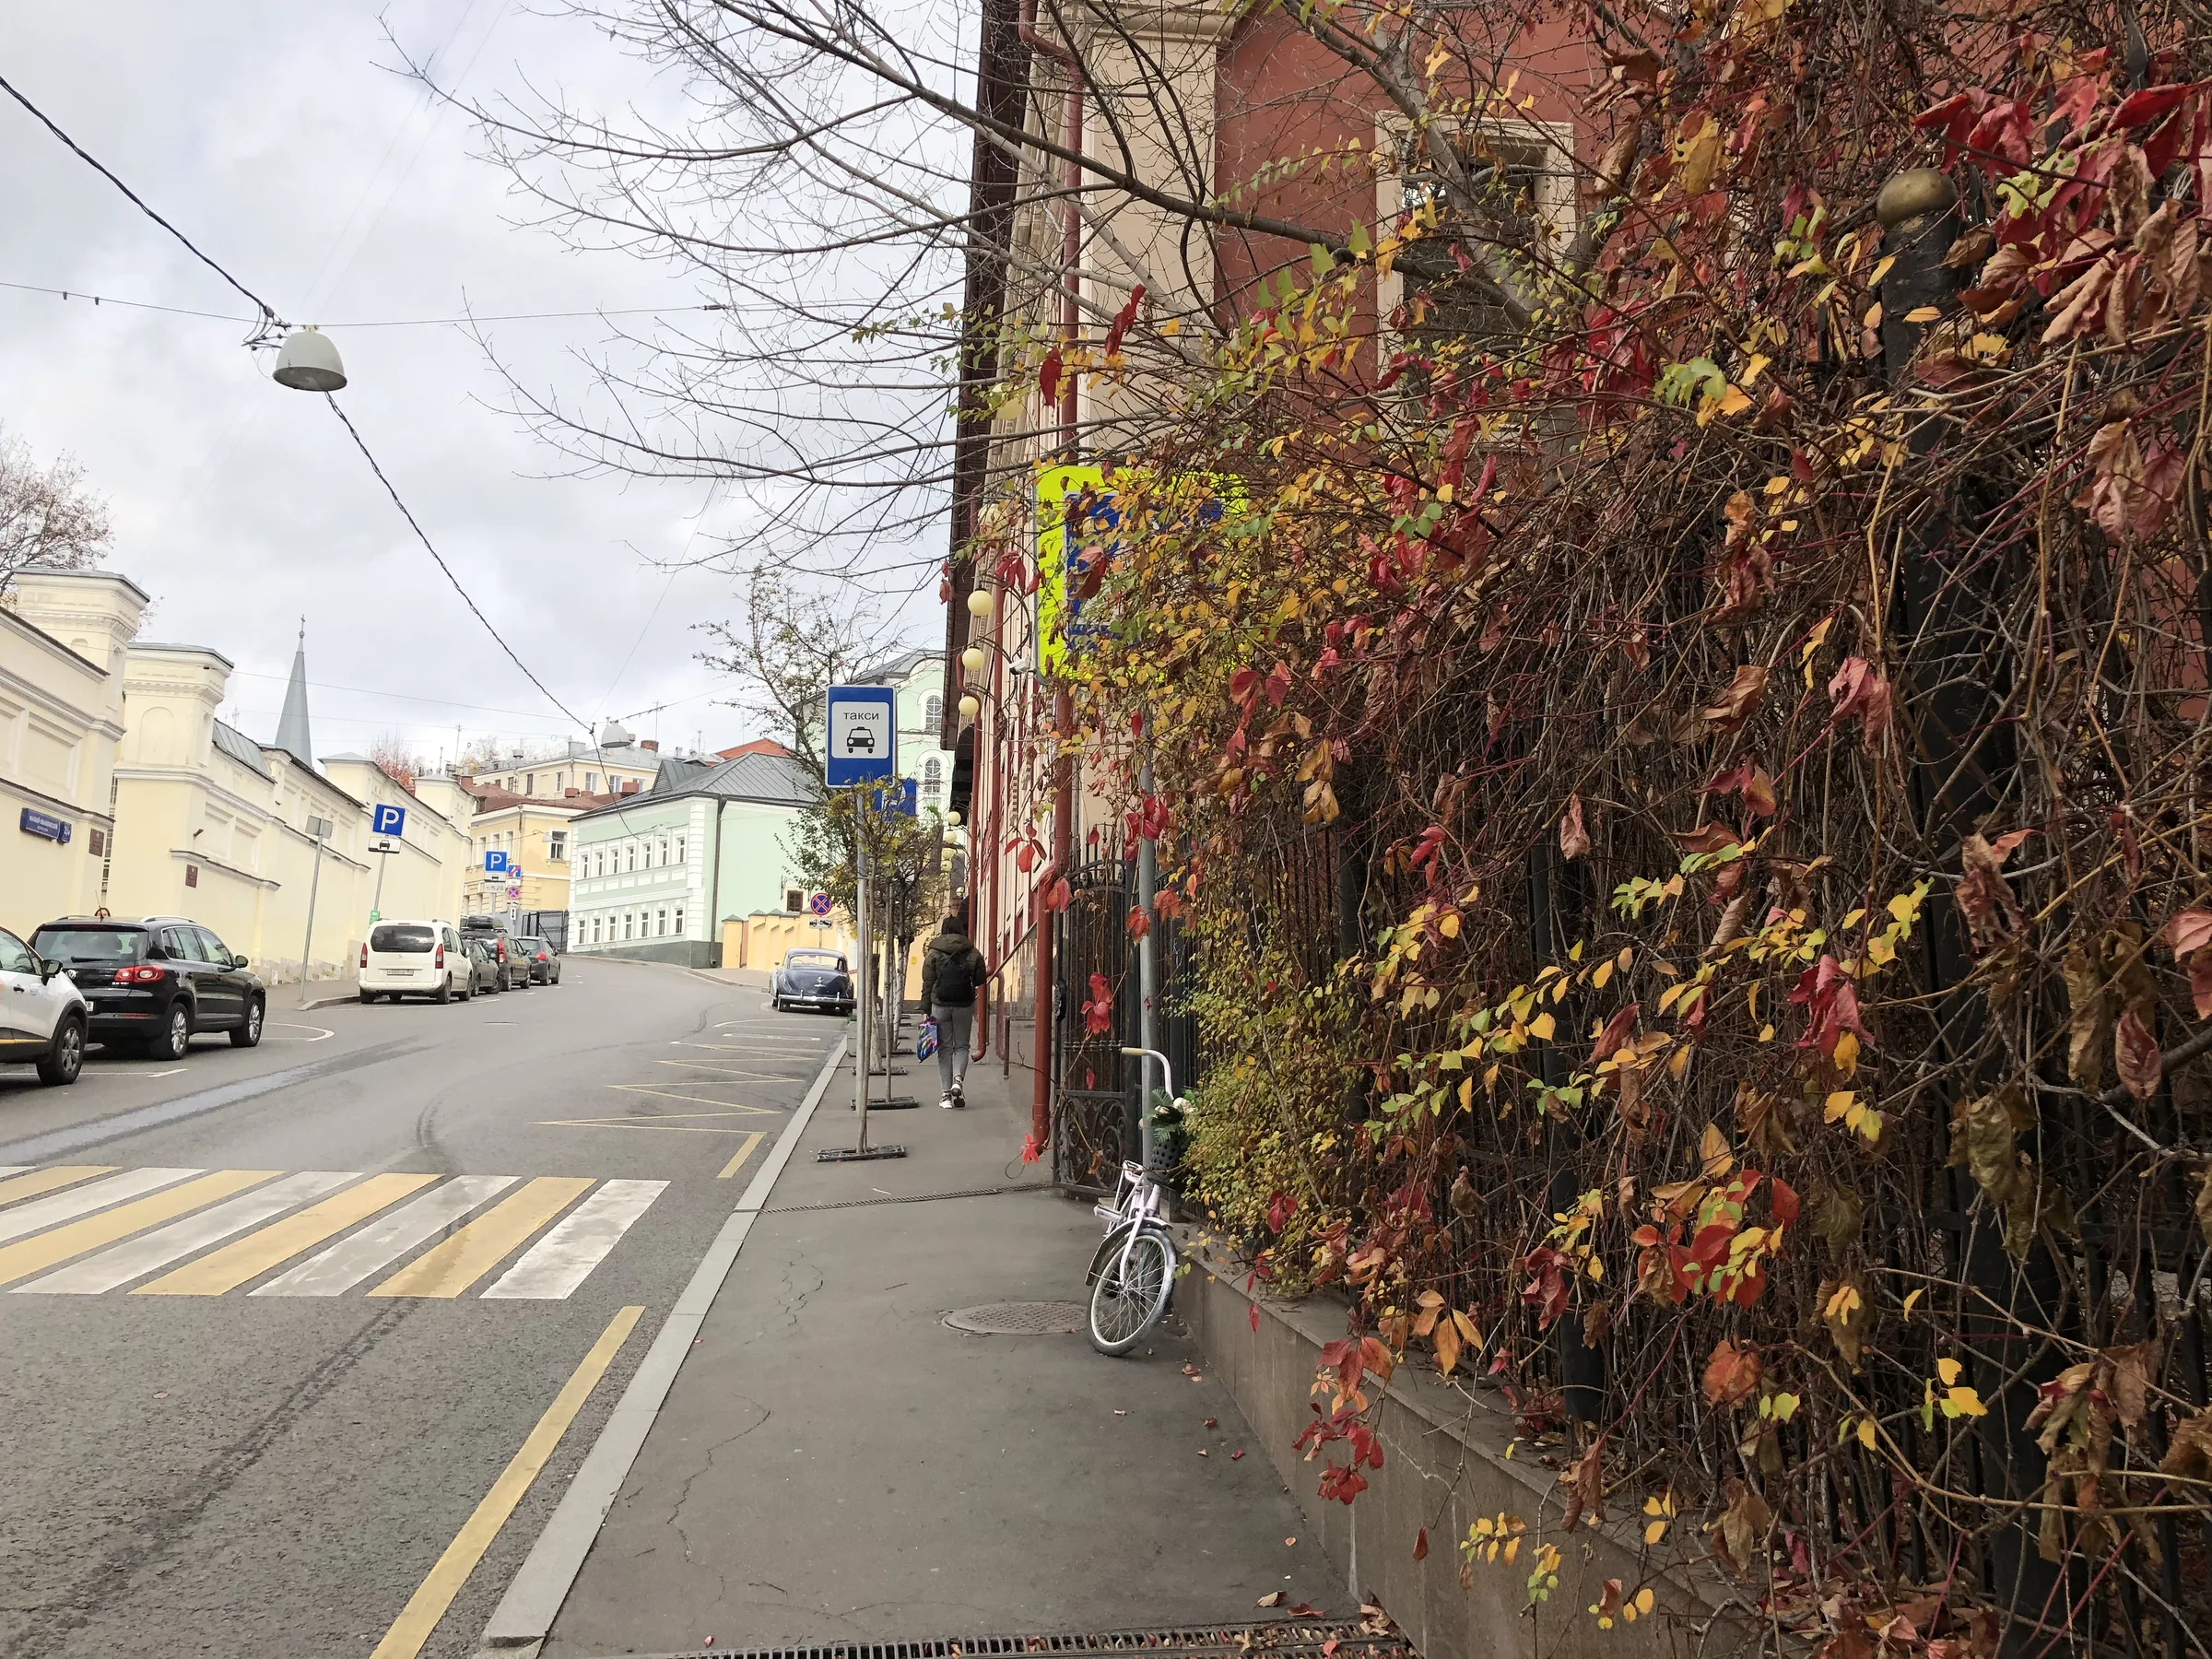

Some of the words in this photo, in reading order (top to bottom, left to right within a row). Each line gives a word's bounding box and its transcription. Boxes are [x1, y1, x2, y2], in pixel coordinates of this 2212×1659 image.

[843, 712, 879, 721] такси
[381, 807, 400, 831] P
[490, 853, 502, 869] P
